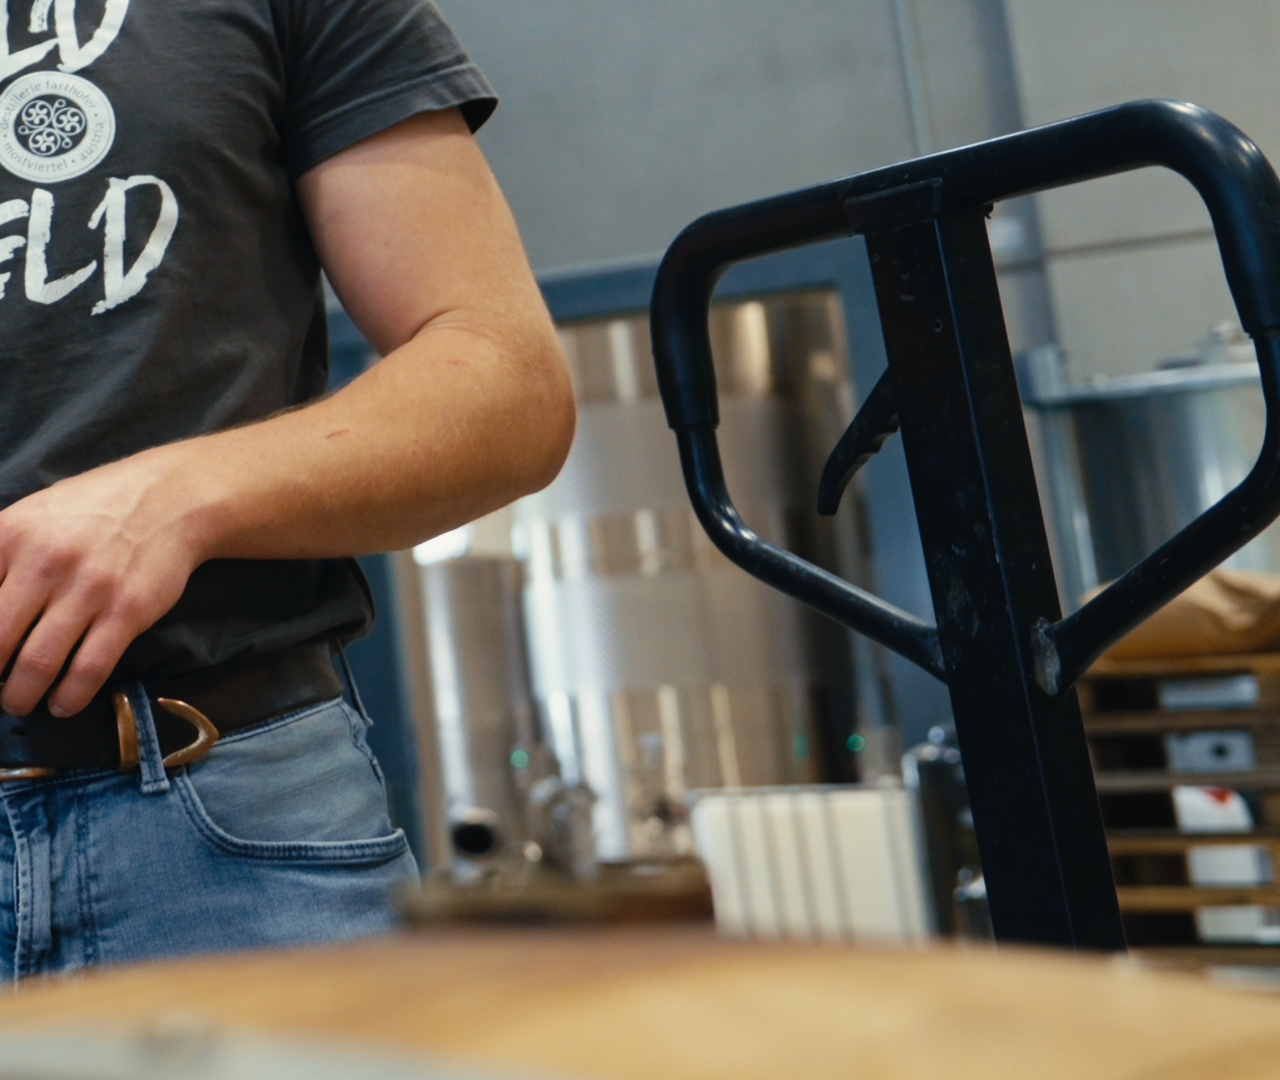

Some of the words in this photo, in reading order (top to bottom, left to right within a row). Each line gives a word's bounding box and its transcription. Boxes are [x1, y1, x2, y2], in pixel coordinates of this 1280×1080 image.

[45, 79, 97, 110] farthofer
[2, 141, 68, 173] mostviertel
[78, 120, 105, 162] austria
